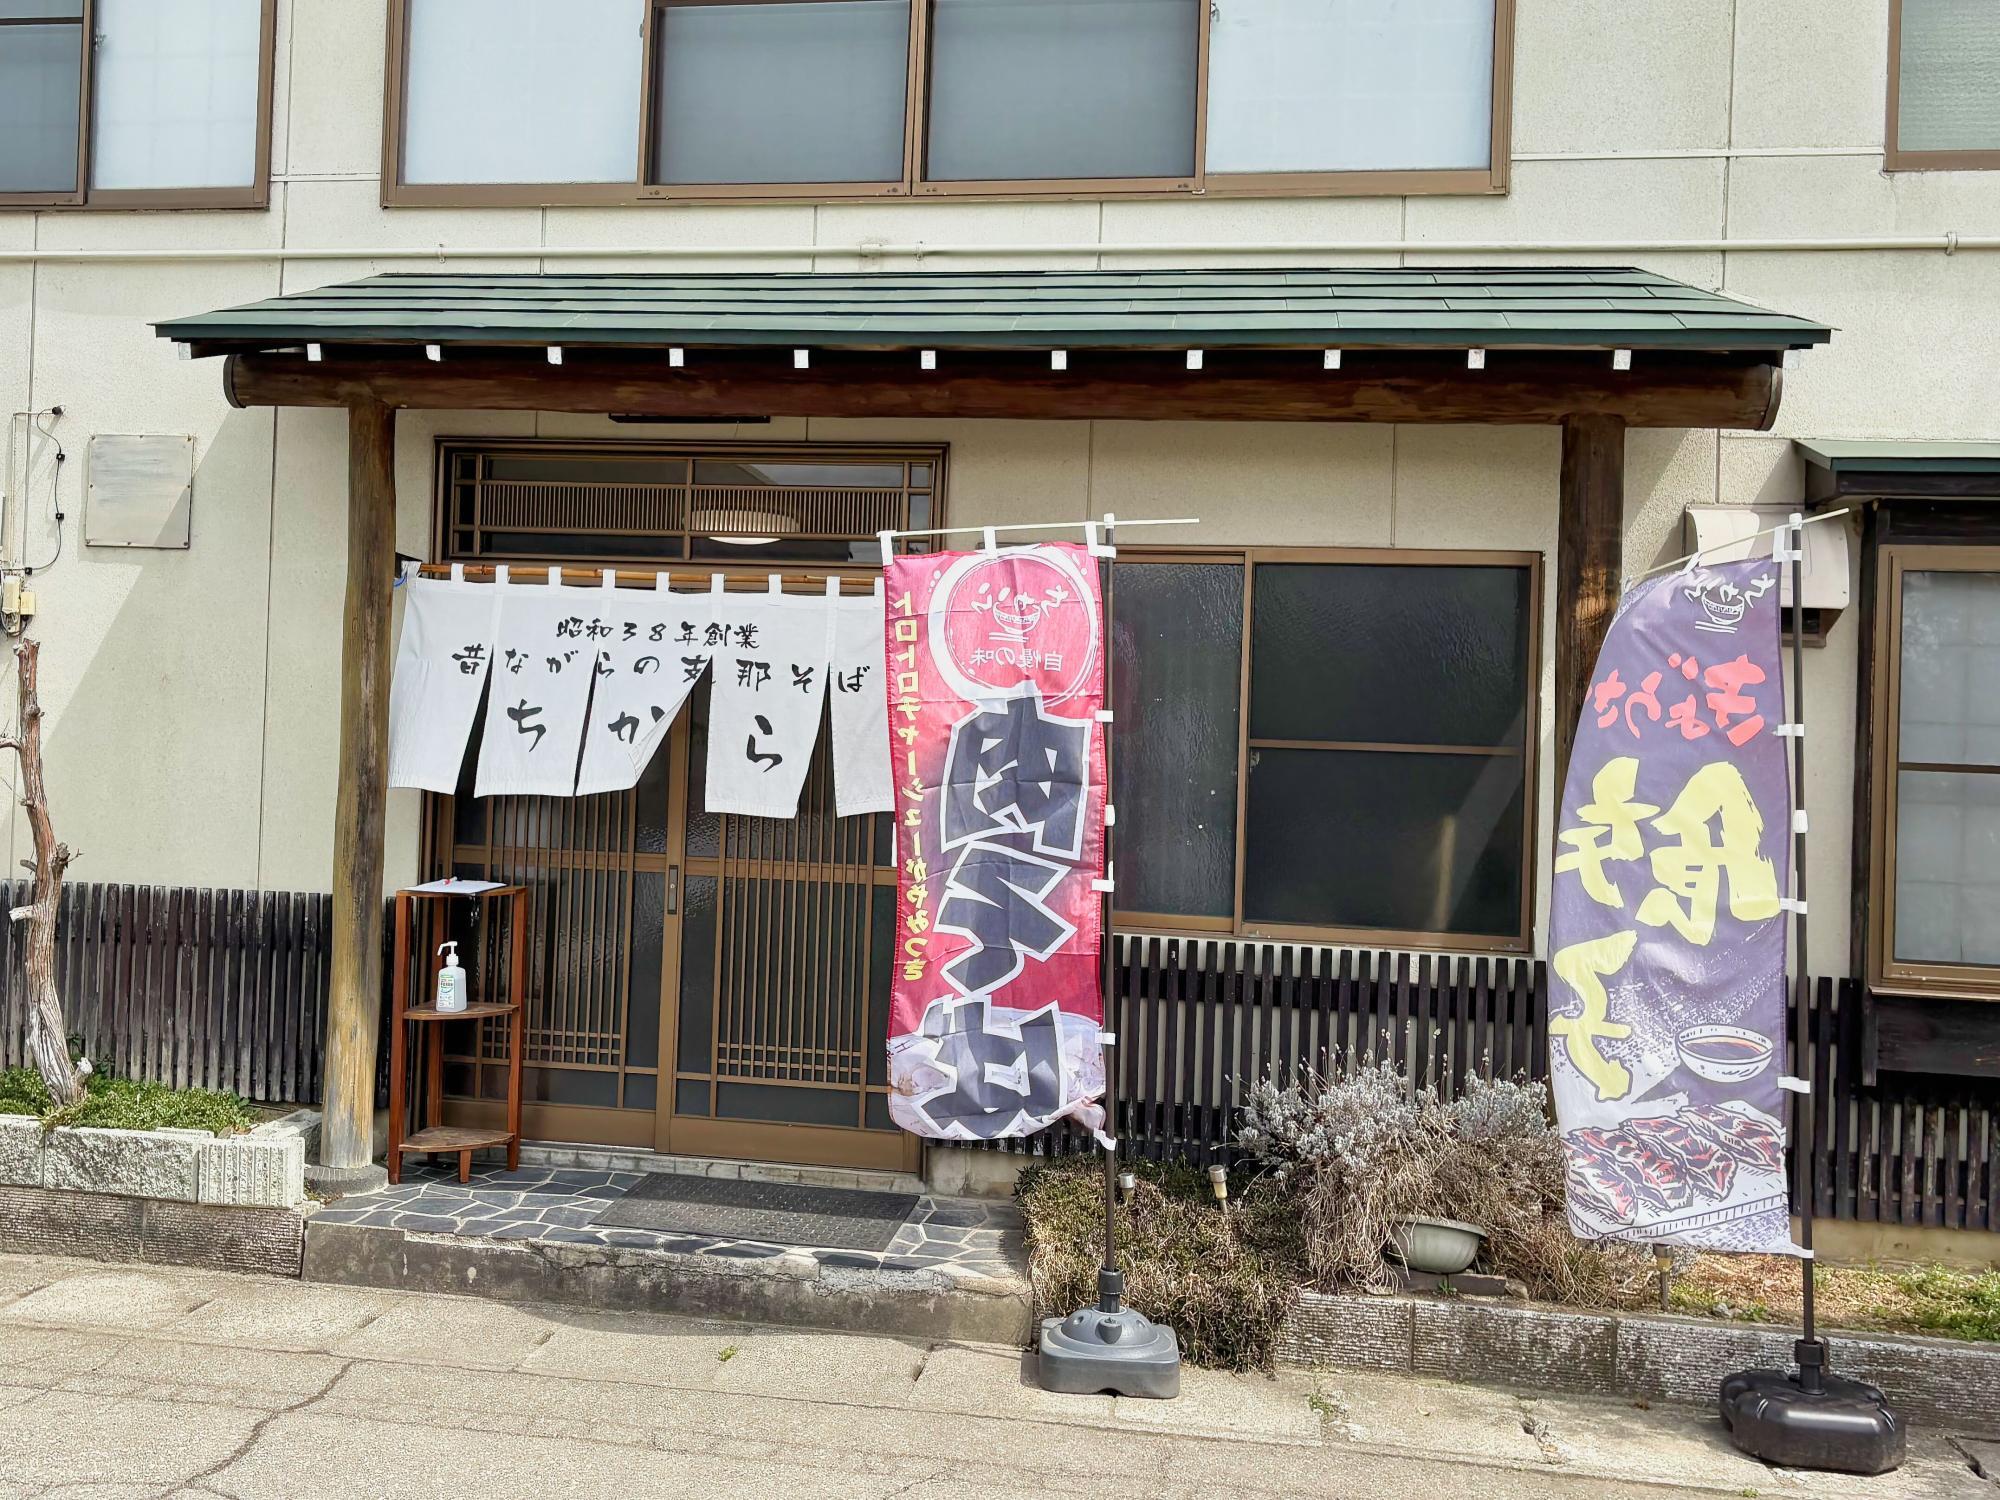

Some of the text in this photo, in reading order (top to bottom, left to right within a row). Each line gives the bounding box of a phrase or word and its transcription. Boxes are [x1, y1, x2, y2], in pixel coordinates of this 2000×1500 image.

[556, 615, 761, 650] 昭和38年創業
[506, 698, 783, 774] ちから
